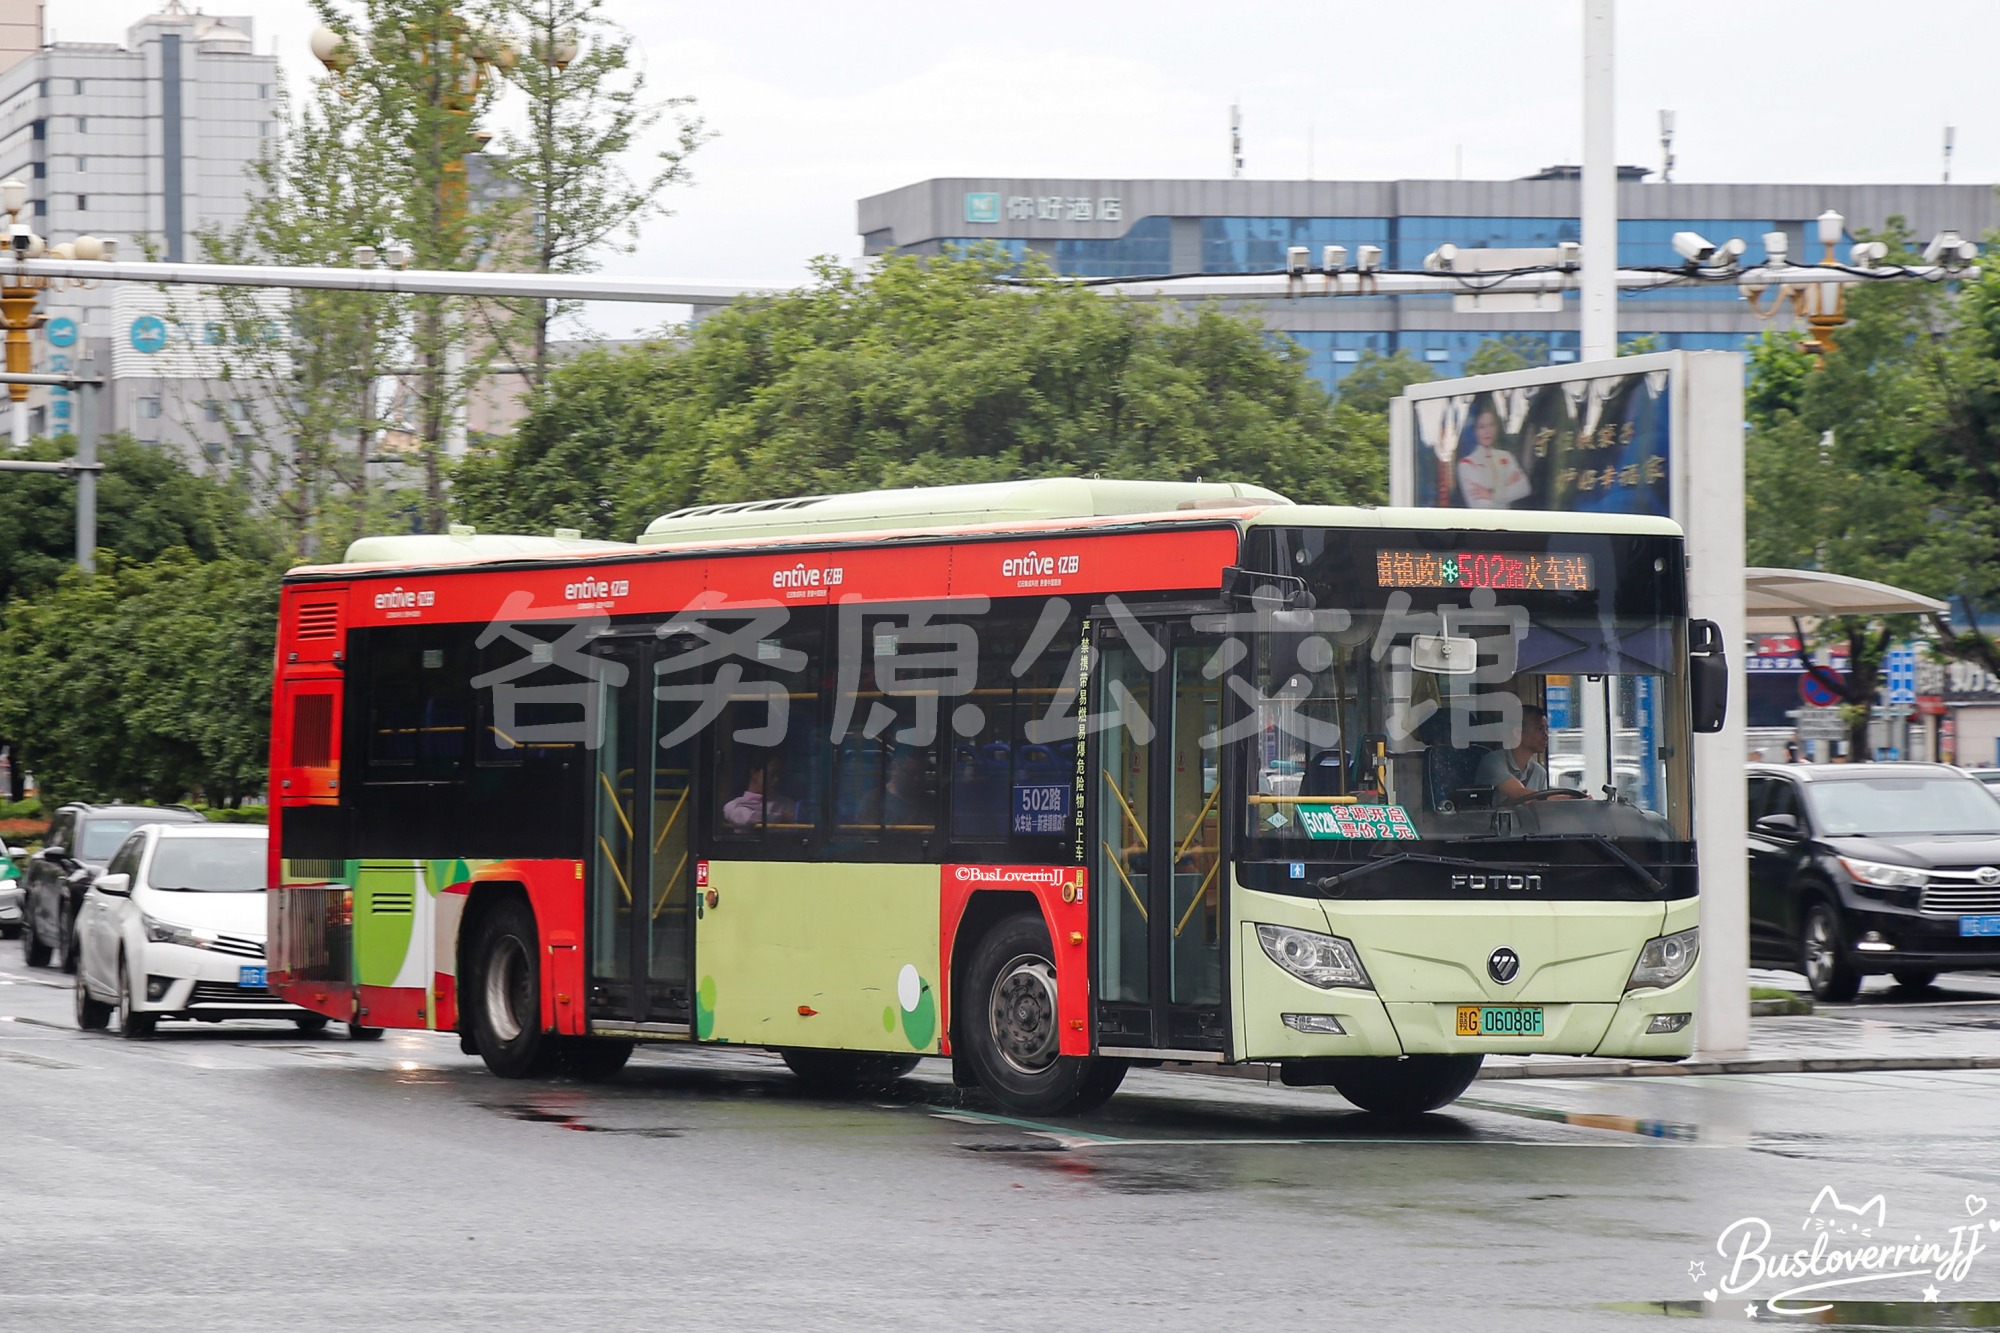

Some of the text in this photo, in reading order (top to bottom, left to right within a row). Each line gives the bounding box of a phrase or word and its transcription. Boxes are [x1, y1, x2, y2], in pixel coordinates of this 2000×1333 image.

[1006, 195, 1123, 222] 你好酒店
[773, 562, 844, 588] entive 亿田
[1002, 550, 1080, 577] entive 亿田
[374, 586, 416, 609] entive
[565, 575, 609, 600] entive
[1076, 620, 1091, 862] 严禁携带易燃易爆危险物品上车
[1022, 787, 1062, 811] 502路
[1303, 805, 1407, 834] 502路 空调开启
[1338, 821, 1415, 840] 票价2元
[1451, 874, 1542, 890] FOTON
